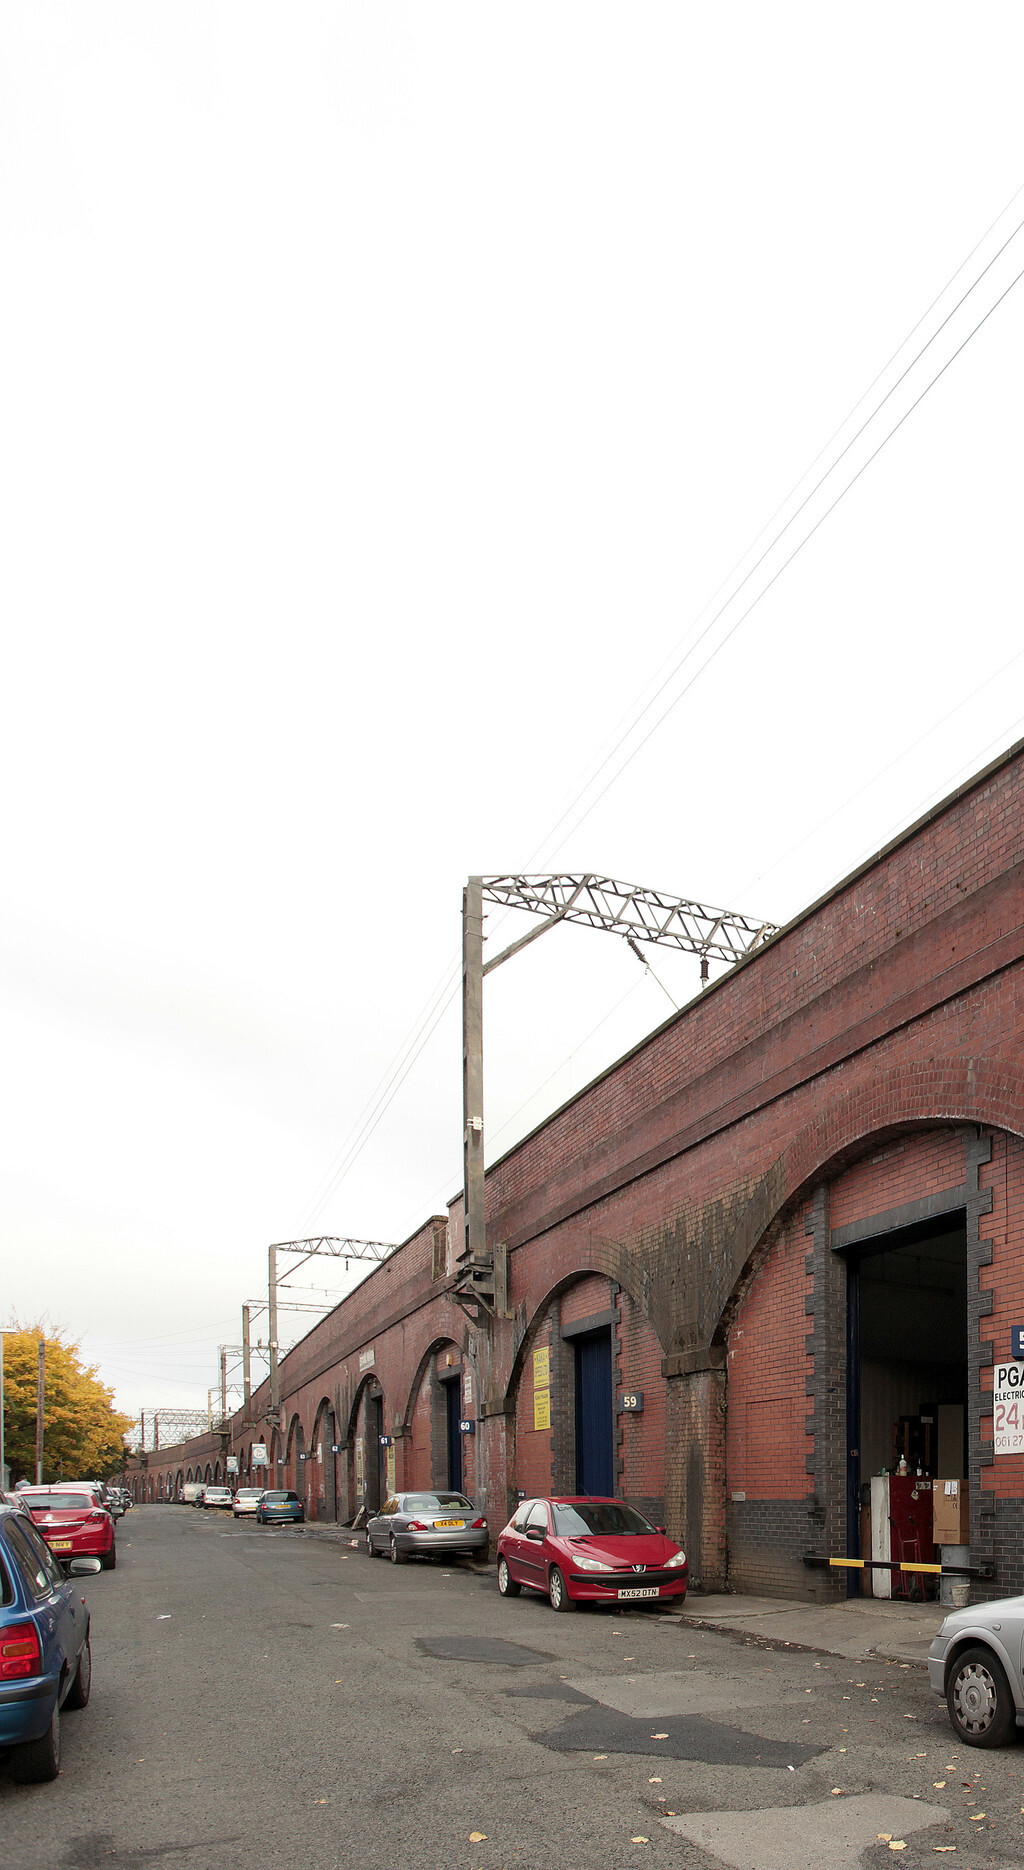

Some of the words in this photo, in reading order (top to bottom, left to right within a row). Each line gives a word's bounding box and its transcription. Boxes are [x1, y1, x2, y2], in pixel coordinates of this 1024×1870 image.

[624, 1396, 637, 1407] 59
[995, 1402, 1019, 1432] 24
[460, 1421, 470, 1430] 60
[620, 1589, 641, 1598] MX52
